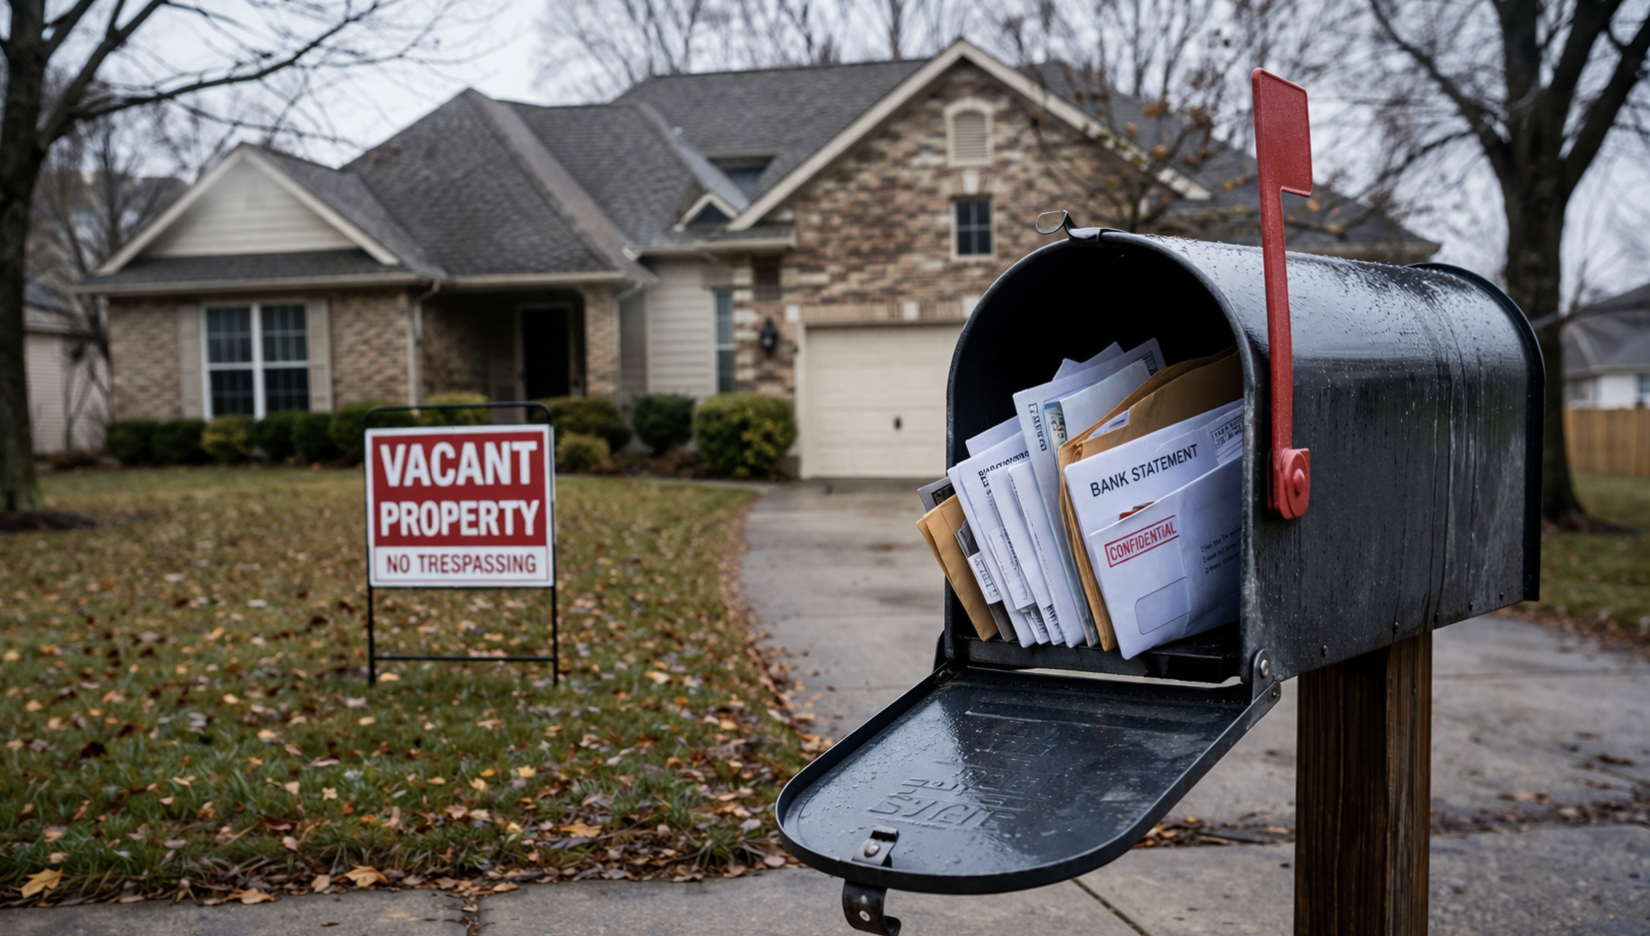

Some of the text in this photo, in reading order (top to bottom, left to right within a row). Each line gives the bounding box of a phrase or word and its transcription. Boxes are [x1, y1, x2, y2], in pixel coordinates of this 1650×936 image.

[379, 441, 538, 487] VACANT
[1090, 444, 1198, 497] BANK STATEMENT
[380, 500, 540, 537] PROPERTY
[1109, 521, 1178, 561] CONFIDENTIAL
[387, 554, 537, 574] NO TRESPASSING
